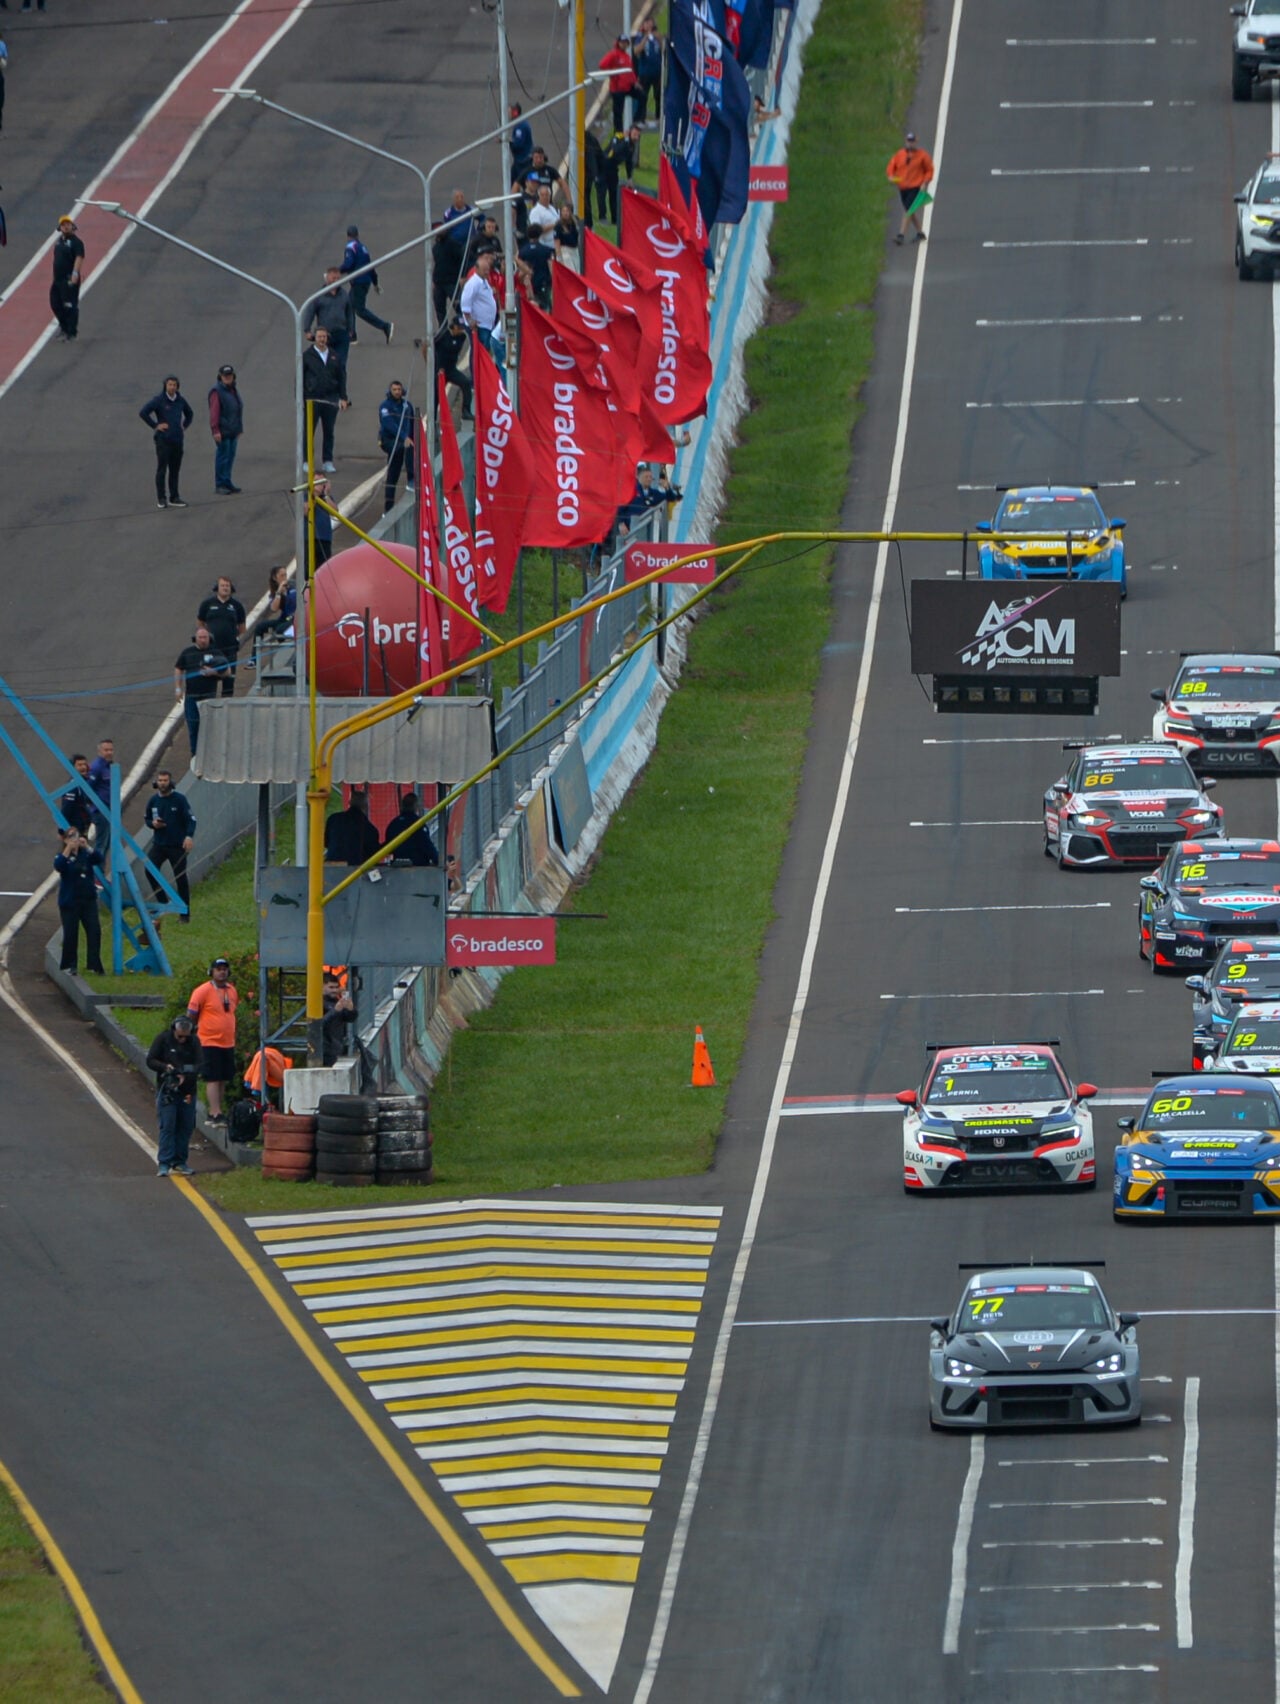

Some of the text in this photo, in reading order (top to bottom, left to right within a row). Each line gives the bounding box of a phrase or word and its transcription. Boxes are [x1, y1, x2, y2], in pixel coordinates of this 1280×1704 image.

[749, 177, 787, 191] desco
[553, 382, 581, 528] bradesco
[647, 554, 708, 569] bradco
[1180, 681, 1208, 694] 88
[1207, 752, 1256, 762] CIVIC
[1084, 774, 1114, 788] 86
[1129, 810, 1164, 818] VOLDA
[1180, 864, 1206, 880] 16
[470, 936, 543, 954] bradesco
[1228, 964, 1247, 979] 9
[1233, 1033, 1258, 1047] 19
[951, 1053, 1017, 1064] OCASA
[944, 1078, 955, 1092] 1
[1152, 1097, 1192, 1113] 60
[973, 1127, 1019, 1136] HONDA
[1065, 1149, 1088, 1162] OCASA
[968, 1297, 1004, 1315] 77
